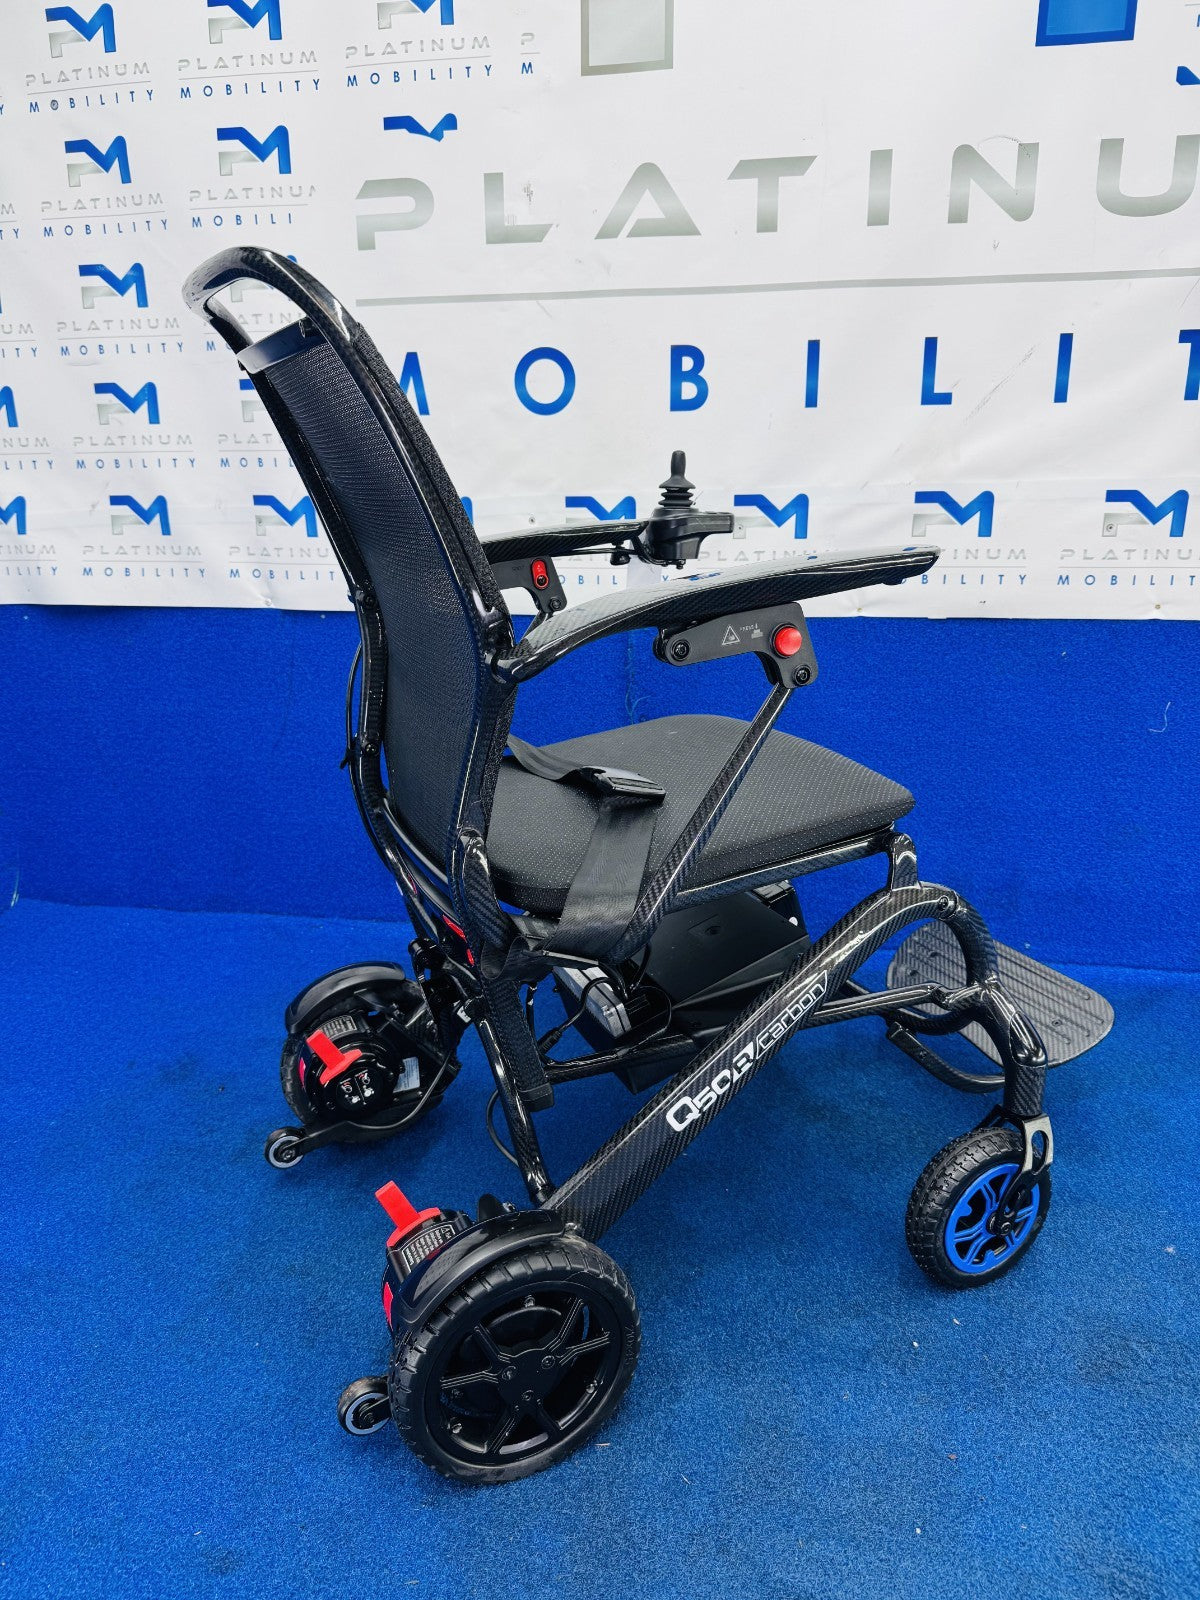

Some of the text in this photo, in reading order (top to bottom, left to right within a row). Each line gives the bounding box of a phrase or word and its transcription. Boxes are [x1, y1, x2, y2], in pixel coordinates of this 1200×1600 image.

[345, 35, 490, 59] PLATINUM
[177, 50, 317, 72] PLATINUM
[25, 62, 150, 87] PLATINUM
[346, 64, 492, 87] MOBILITY
[180, 79, 320, 99] MOBILITY
[355, 134, 1200, 251] PLATINU
[41, 193, 163, 213] PLATINUM
[43, 219, 168, 238] MOBILITY
[191, 212, 292, 228] MOBILI
[57, 316, 180, 332] PLATINUM
[60, 342, 184, 357] MOBILITY
[73, 435, 192, 447] PLATINUM
[76, 458, 196, 469] MOBILITY
[82, 544, 202, 556] PLATINUM
[82, 566, 206, 577] MOBILITY
[229, 568, 336, 581] MOBILIT
[1057, 573, 1196, 586] MOBILIT
[666, 982, 824, 1132] Q50R carbon
